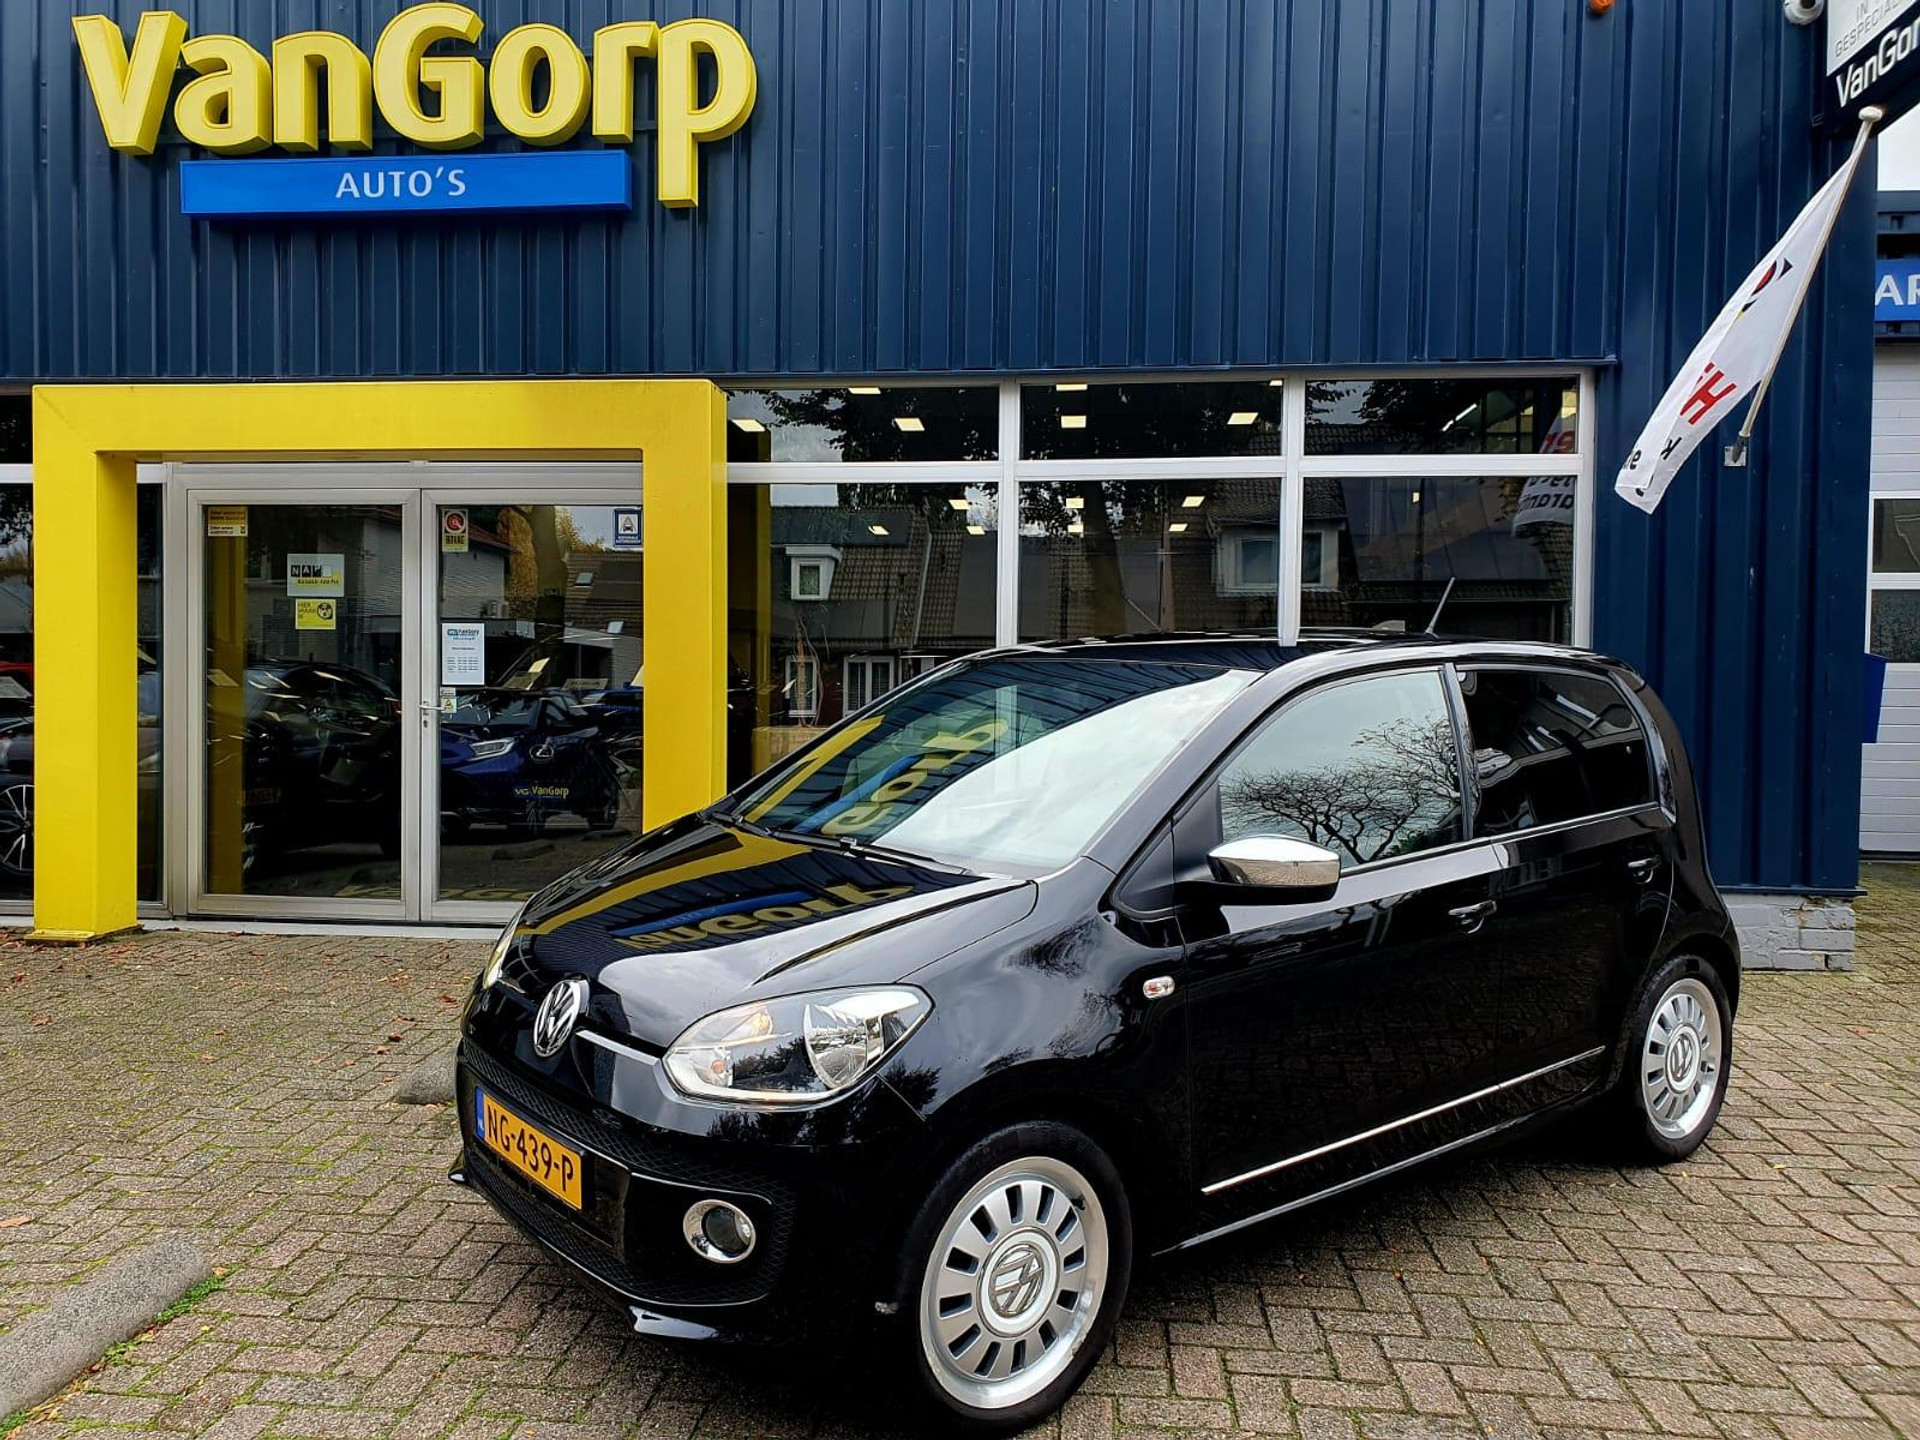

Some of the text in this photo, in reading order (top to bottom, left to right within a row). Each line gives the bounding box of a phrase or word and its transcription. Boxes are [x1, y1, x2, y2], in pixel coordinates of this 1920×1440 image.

[71, 2, 757, 208] VanGorp
[335, 166, 466, 198] AUTO'S
[531, 785, 570, 800] VanGorp
[487, 1104, 575, 1194] NG-439-P
